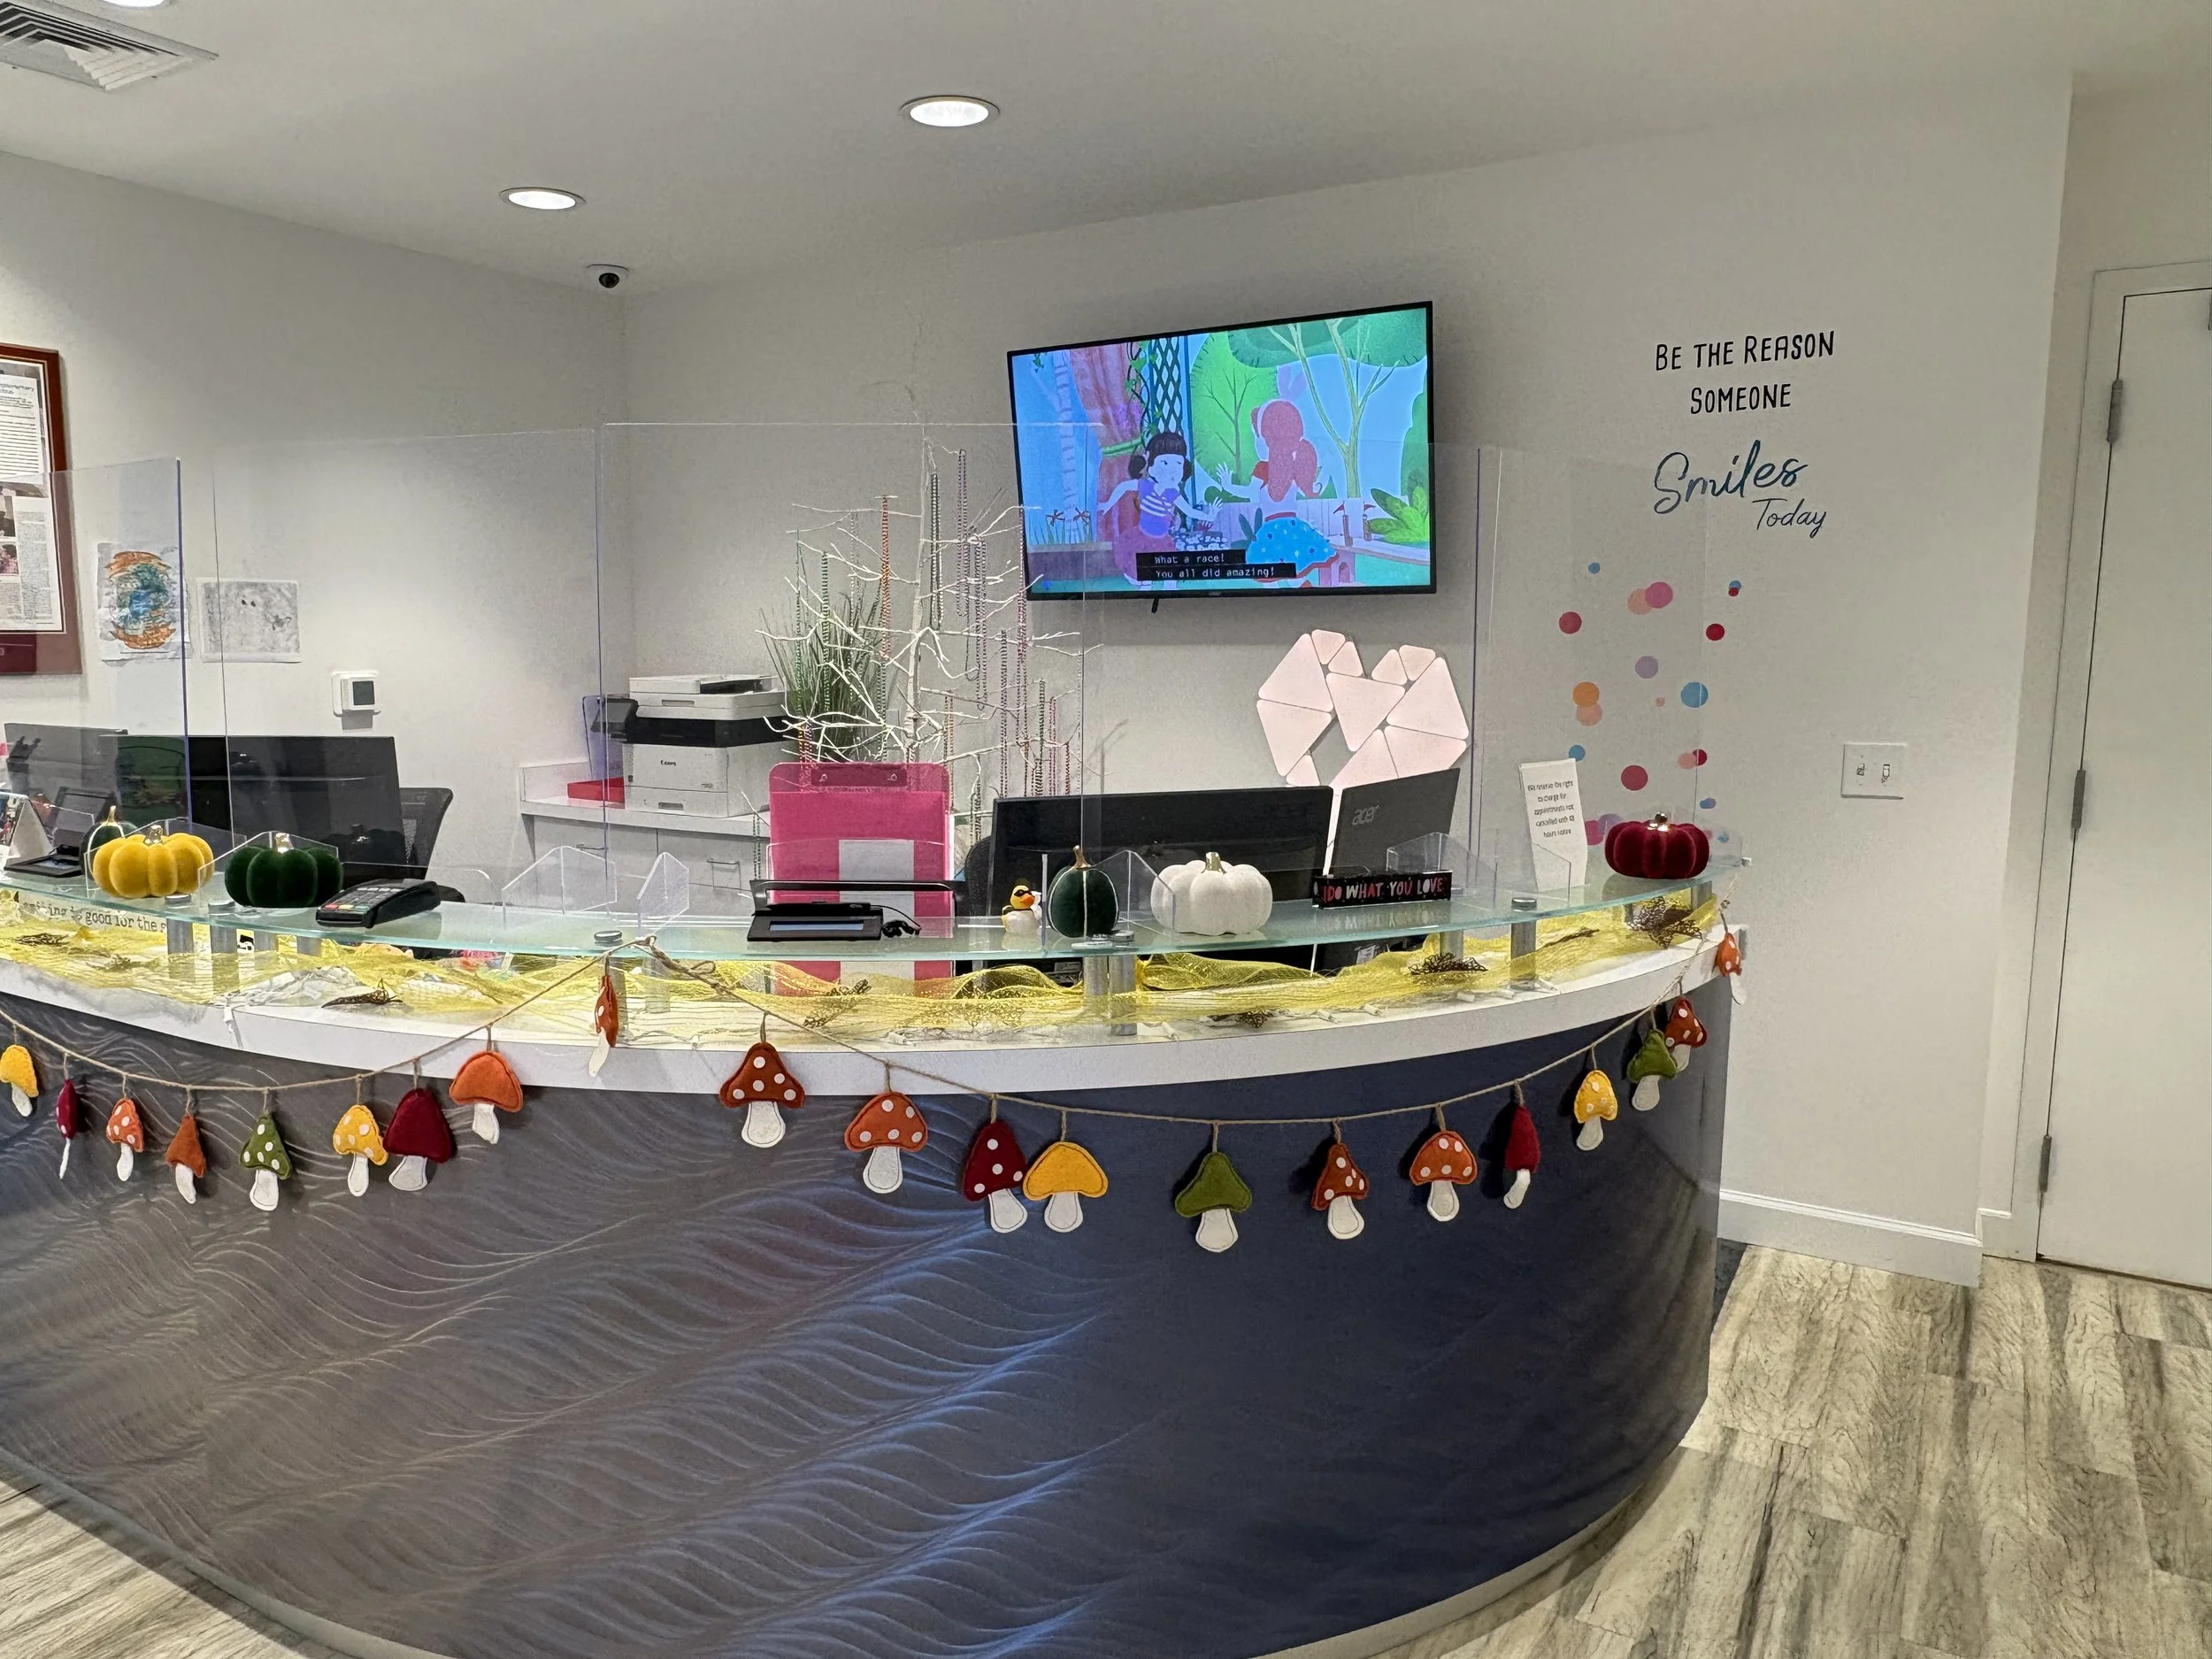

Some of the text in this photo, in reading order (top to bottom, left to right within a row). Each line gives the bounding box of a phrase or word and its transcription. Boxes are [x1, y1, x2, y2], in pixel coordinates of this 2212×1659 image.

[1655, 330, 1835, 371] BE THE REASON
[1690, 383, 1792, 414] SOMEONE
[1654, 440, 1809, 515] Smiles
[1752, 497, 1827, 539] Today
[1154, 555, 1179, 565] What
[1196, 553, 1225, 563] race!
[1179, 568, 1195, 578] all
[1202, 568, 1220, 577] did
[1226, 566, 1274, 578] amazing!
[1346, 881, 1384, 900] WHAT
[1389, 879, 1413, 897] YOU
[1417, 877, 1444, 895] LOVE
[137, 915, 158, 933] the
